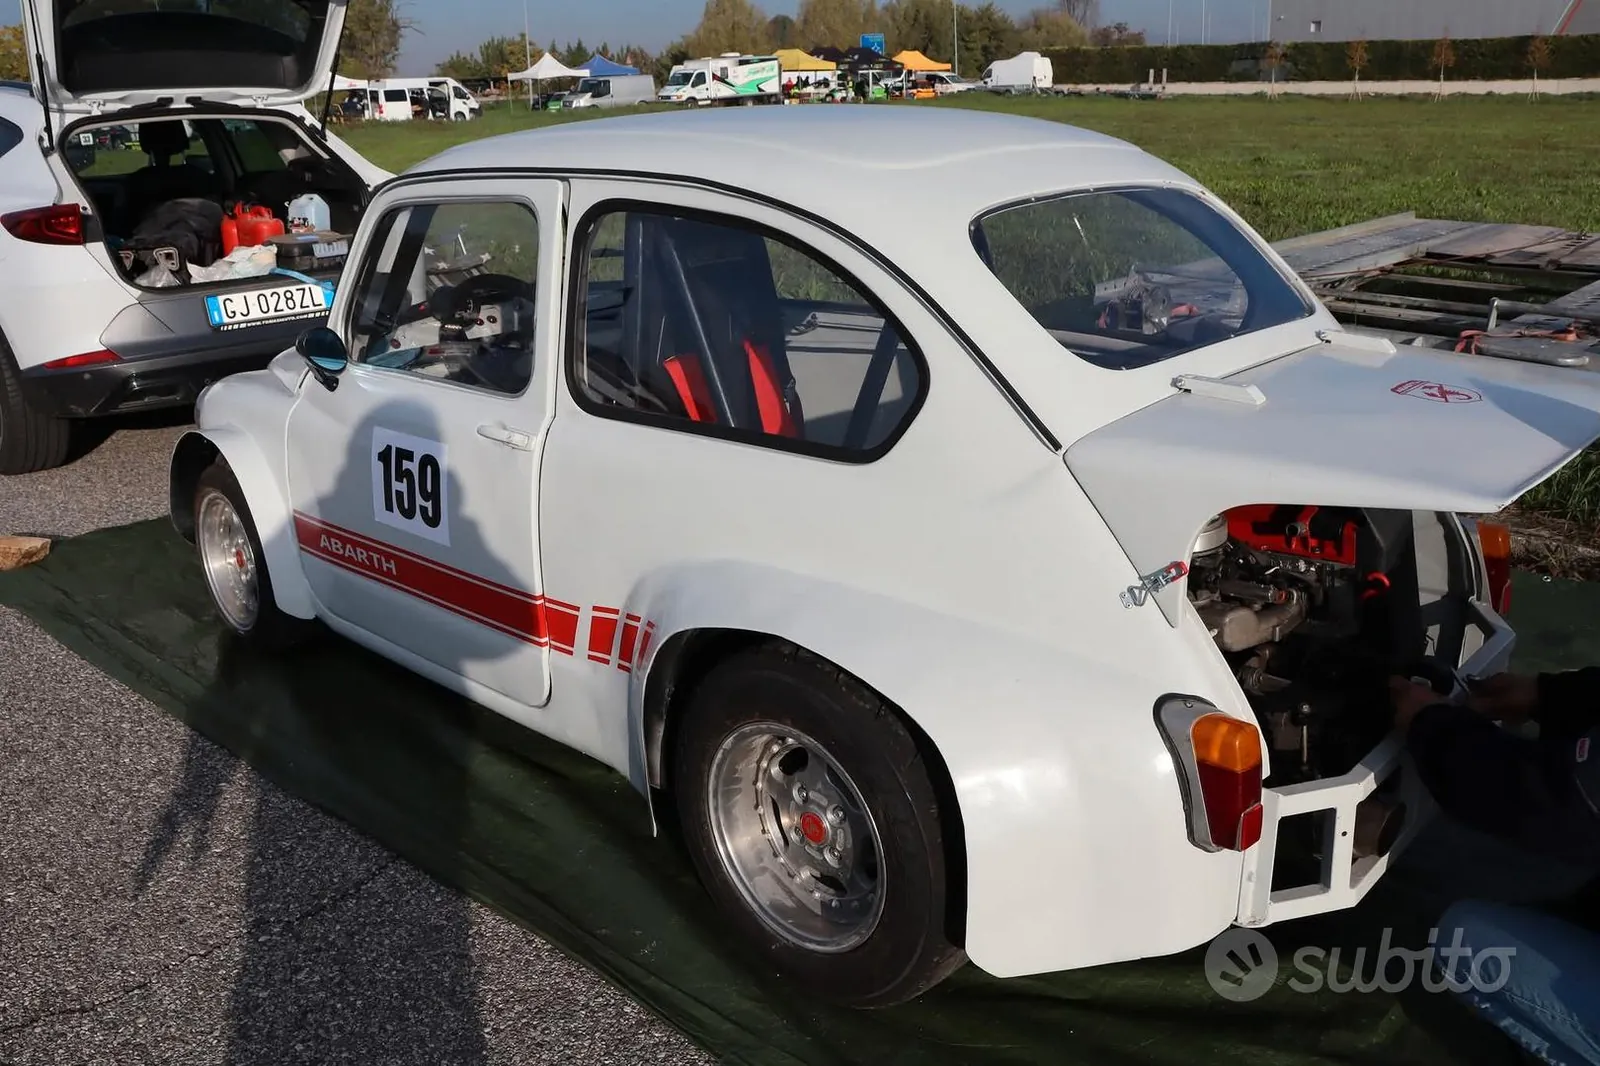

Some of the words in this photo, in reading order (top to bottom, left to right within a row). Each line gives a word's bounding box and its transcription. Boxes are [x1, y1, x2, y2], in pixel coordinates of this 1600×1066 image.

[223, 295, 250, 319] GJ
[257, 286, 322, 314] 028ZL
[377, 444, 442, 528] 159
[320, 534, 397, 576] ABARTH
